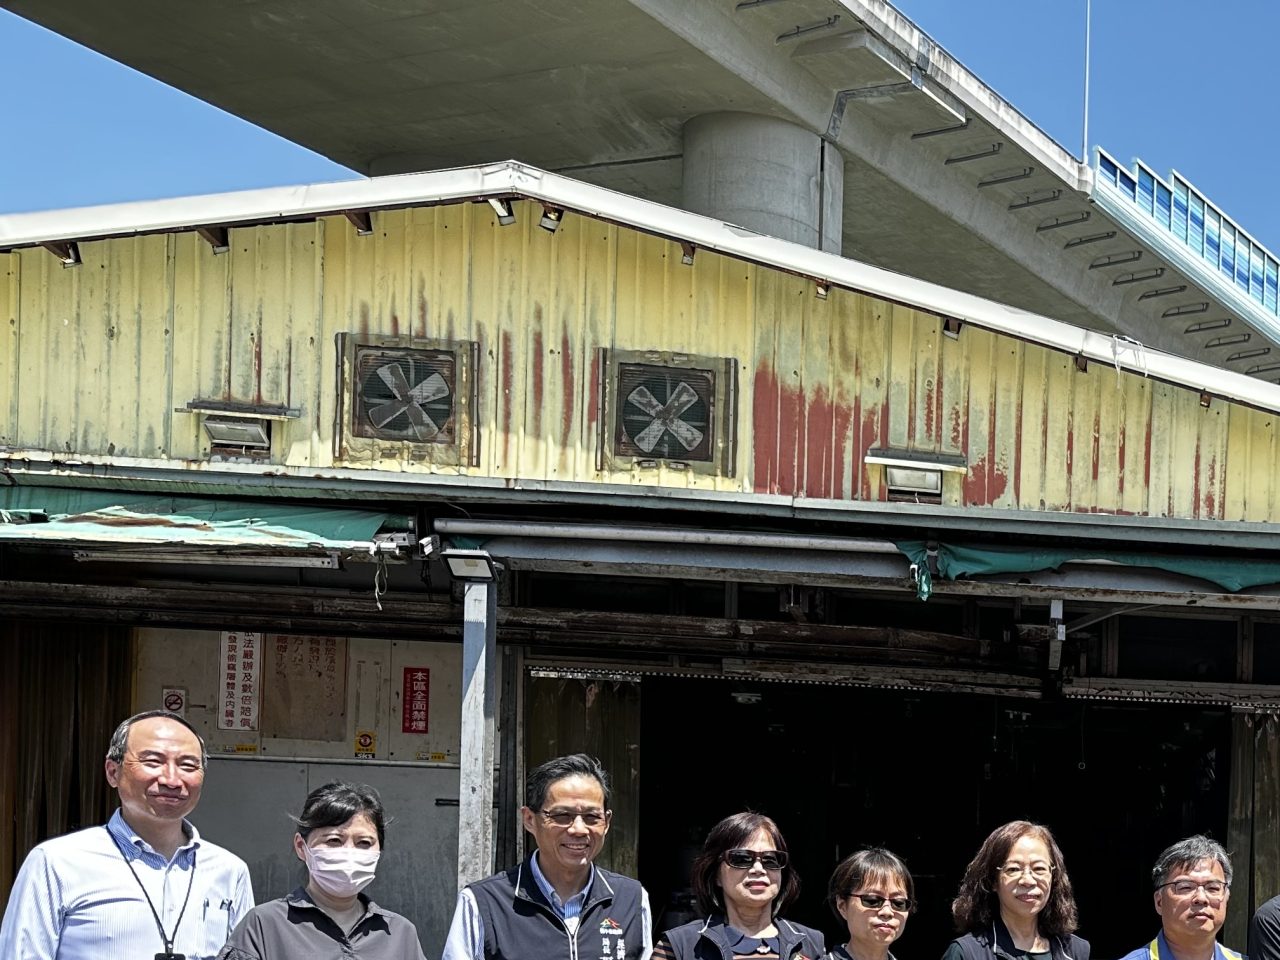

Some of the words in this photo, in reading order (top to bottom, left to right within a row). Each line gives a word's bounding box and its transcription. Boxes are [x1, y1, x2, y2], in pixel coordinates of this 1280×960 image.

[225, 632, 237, 727] 發現偷竊屠體及內臟者
[411, 671, 428, 731] 本區全面禁煙
